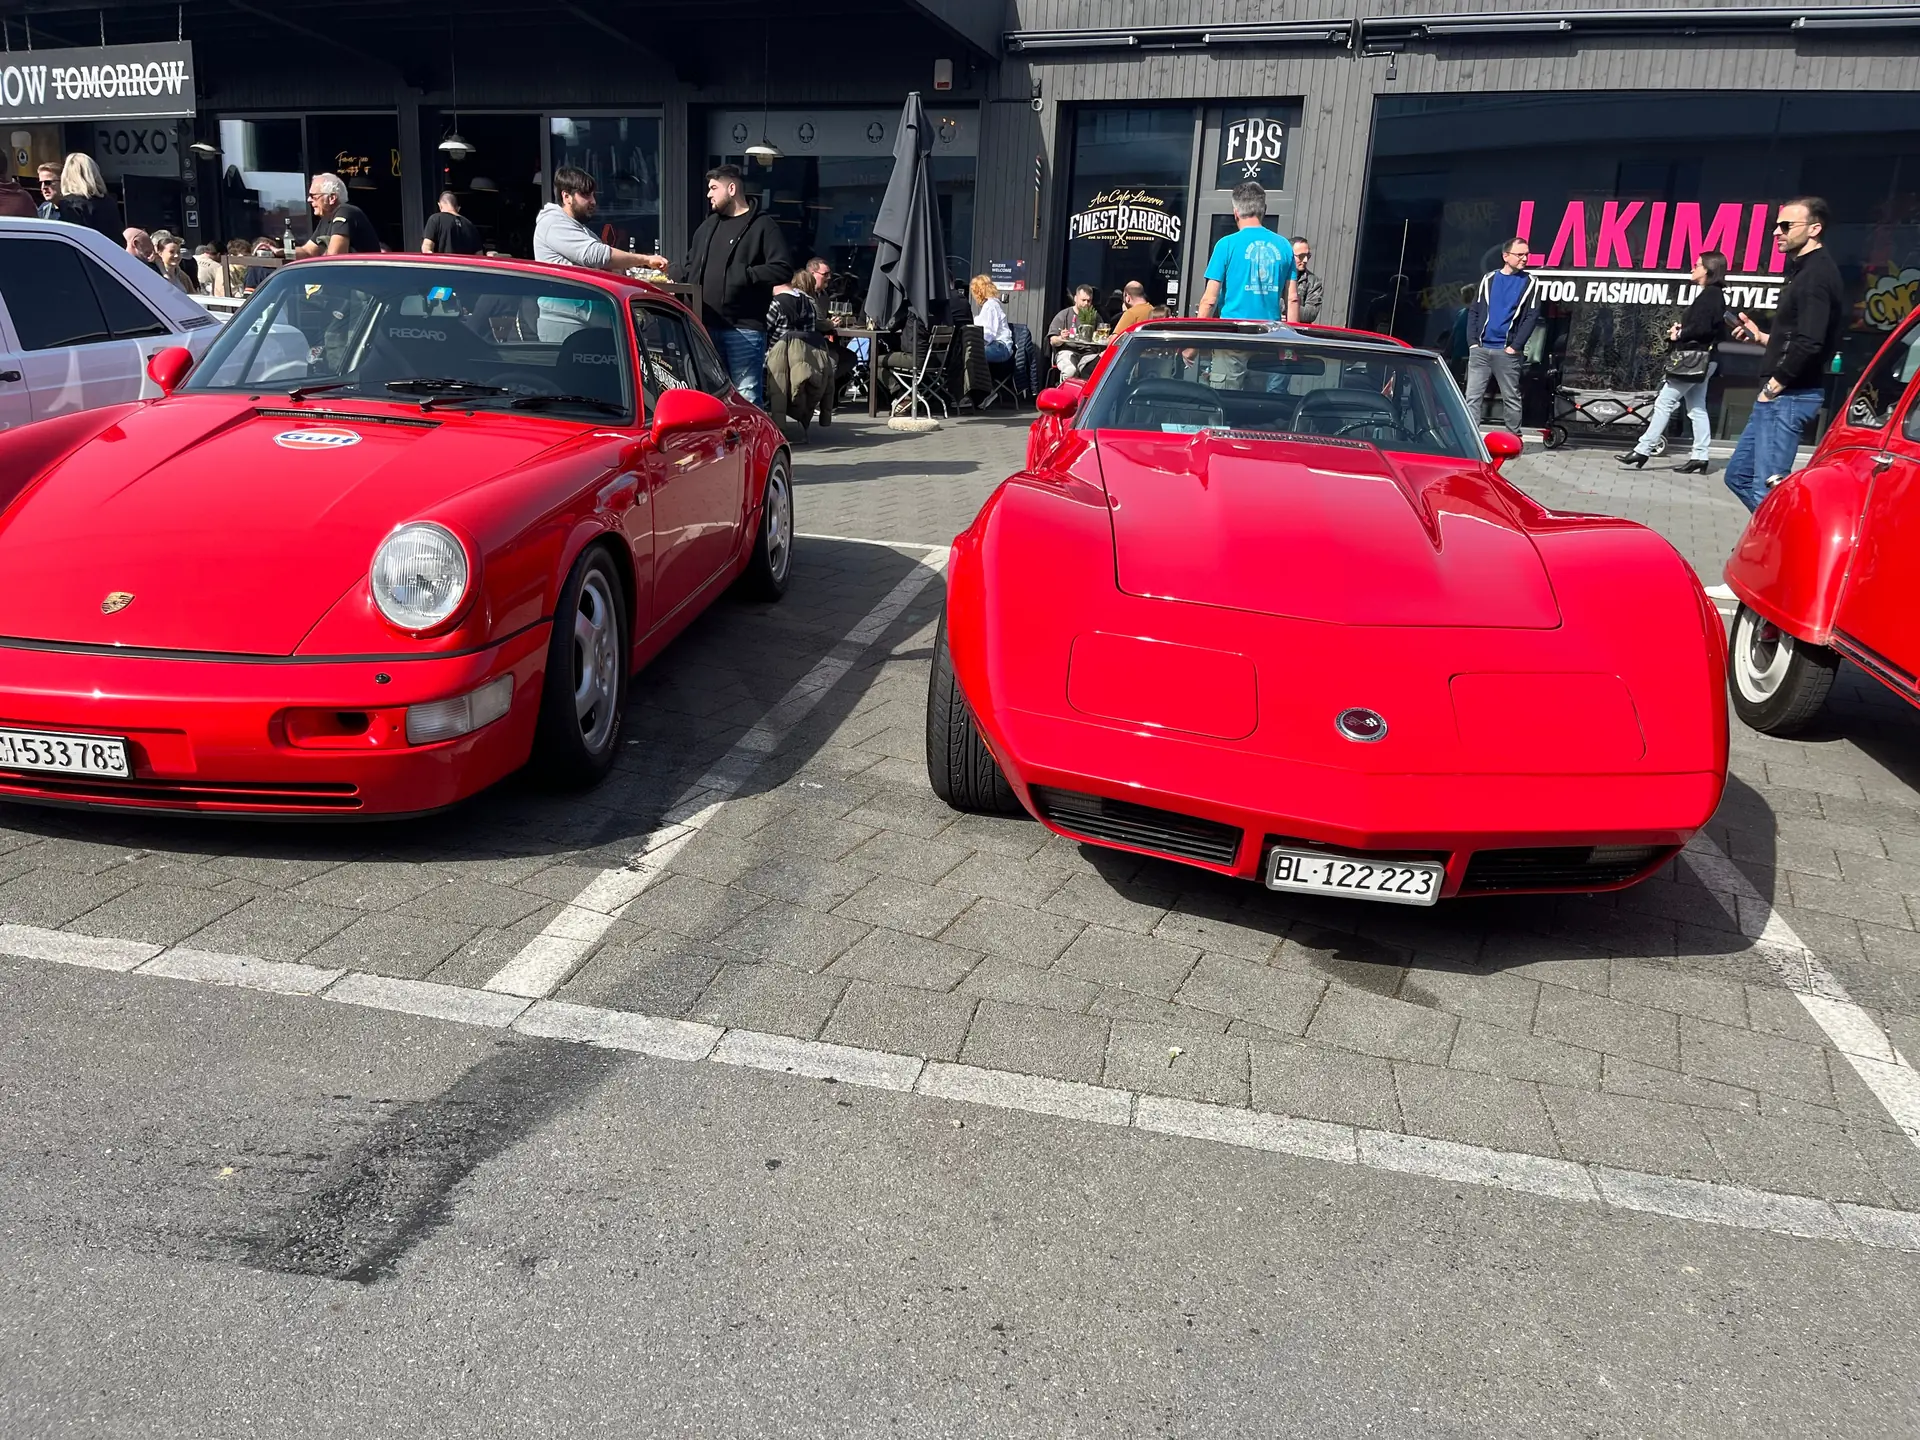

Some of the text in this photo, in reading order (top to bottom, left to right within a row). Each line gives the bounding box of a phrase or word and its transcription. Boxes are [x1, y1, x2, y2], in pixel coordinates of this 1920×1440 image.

[0, 60, 187, 106] OW TOMORROW
[1226, 118, 1283, 160] FBS
[1088, 189, 1164, 208] Ace Cafe Luzern
[1069, 204, 1181, 242] FINEST BARBERS
[1584, 282, 1672, 304] FASHION.
[389, 327, 447, 341] RECARO
[280, 433, 357, 444] Gulf
